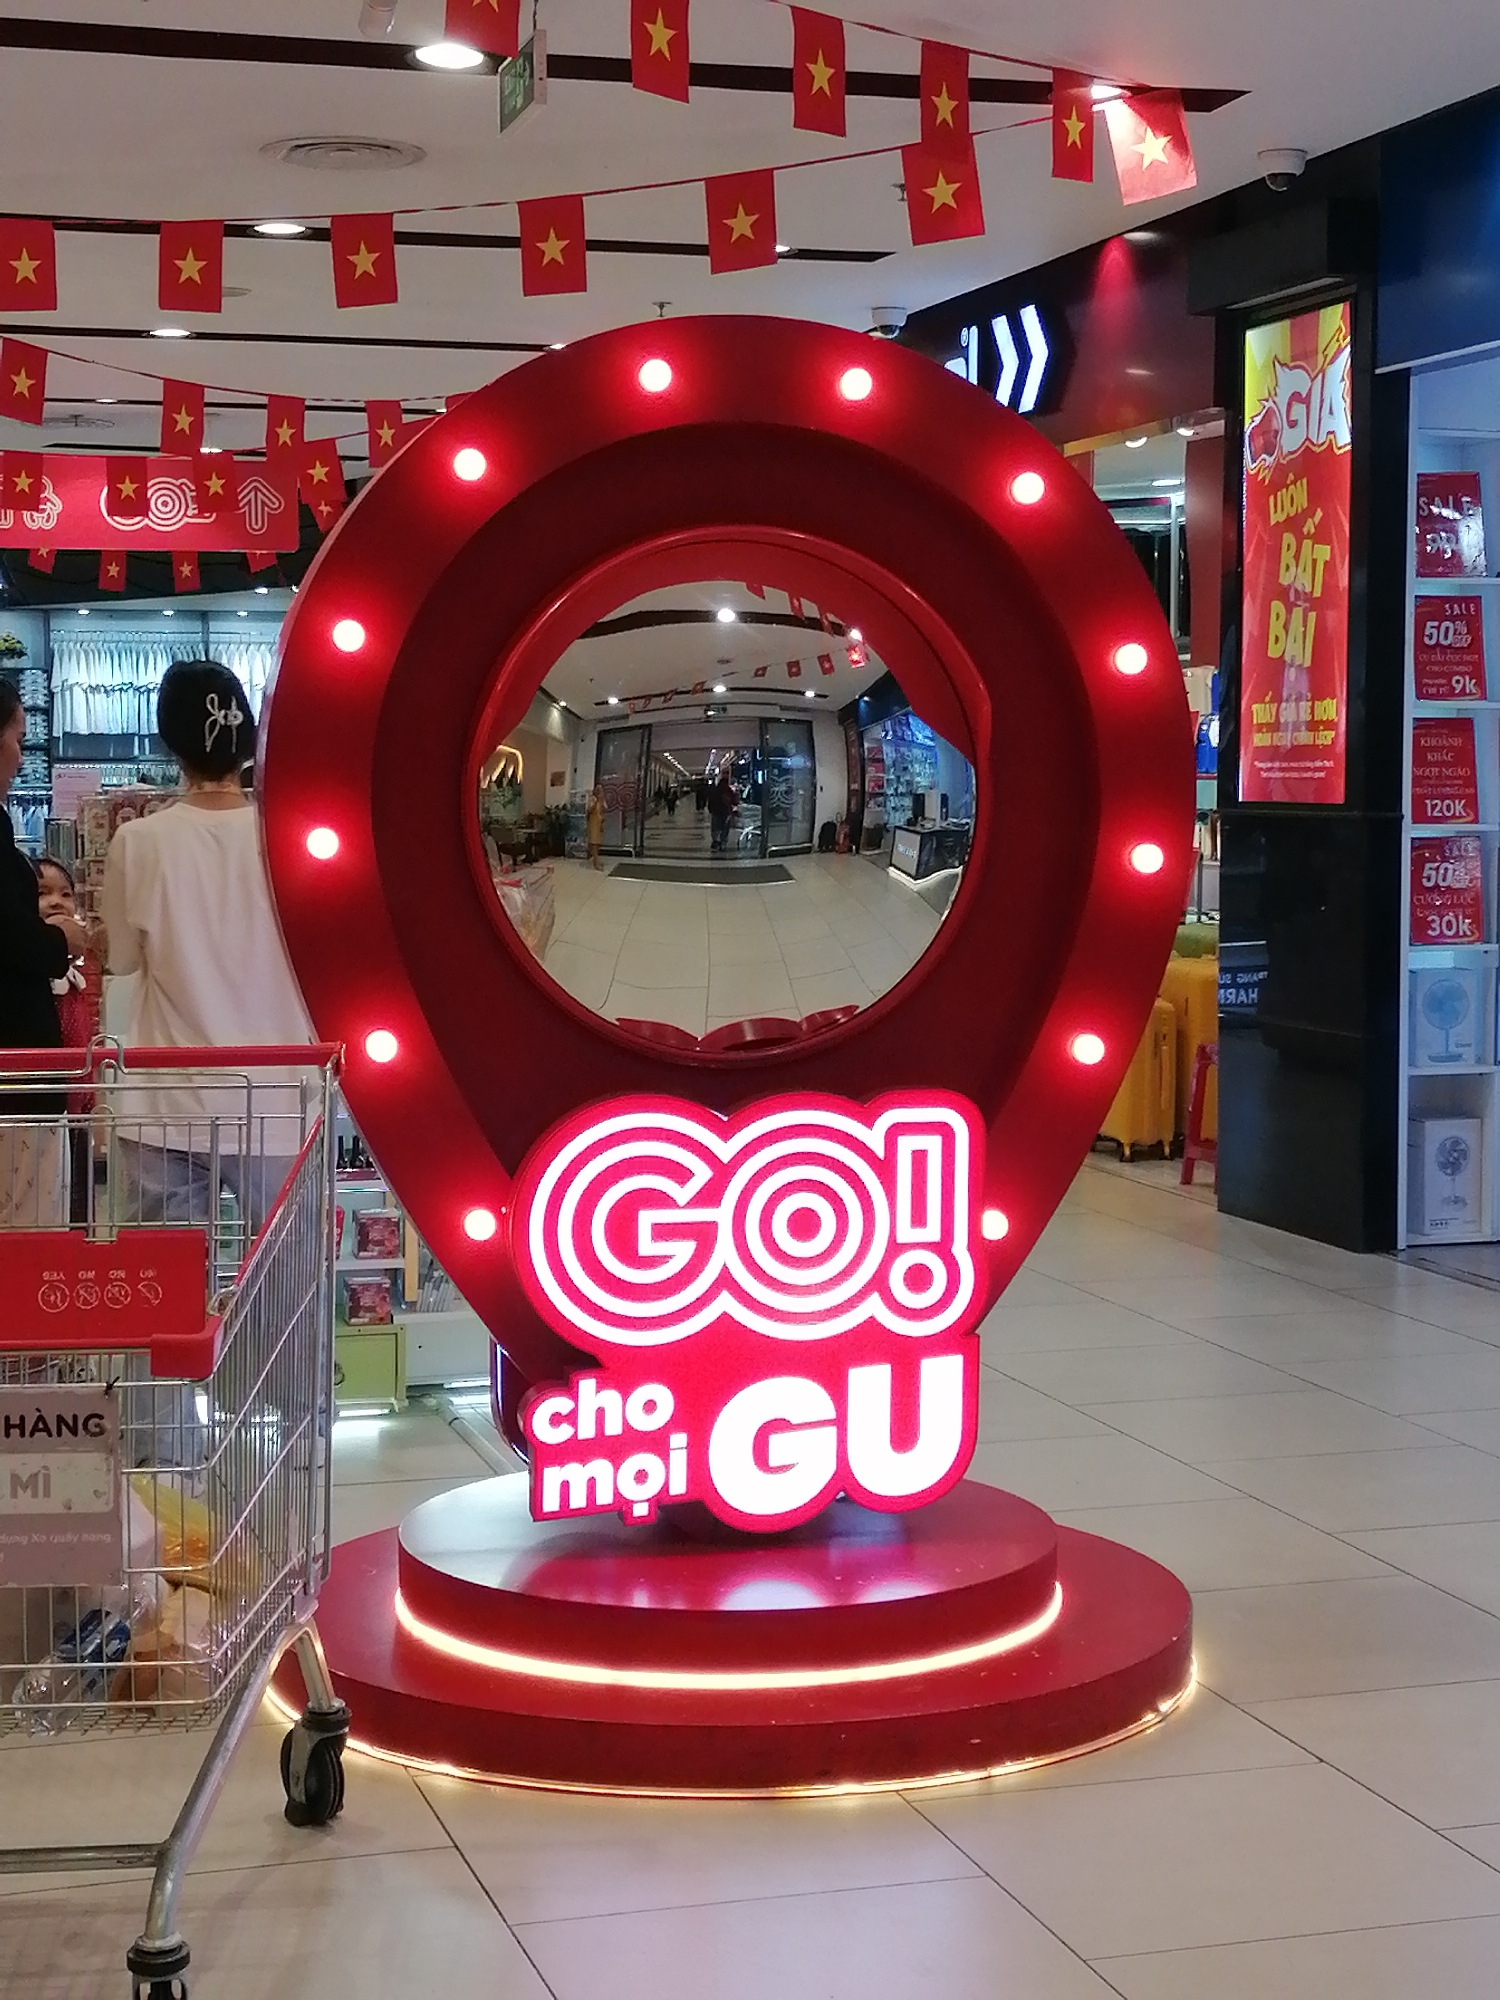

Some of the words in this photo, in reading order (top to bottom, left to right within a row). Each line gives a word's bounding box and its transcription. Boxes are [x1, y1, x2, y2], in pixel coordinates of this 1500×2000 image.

[1268, 471, 1308, 526] LUÔN
[1279, 508, 1331, 597] BẤT
[1444, 603, 1476, 615] SALE
[1452, 675, 1478, 694] 9k
[1424, 800, 1468, 817] 120K
[1426, 914, 1472, 937] 30k
[529, 1107, 974, 1346] GO!
[4, 1408, 106, 1438] HÀNG
[532, 1378, 674, 1444] cho
[709, 1354, 964, 1515] GU
[542, 1433, 688, 1516] mọi
